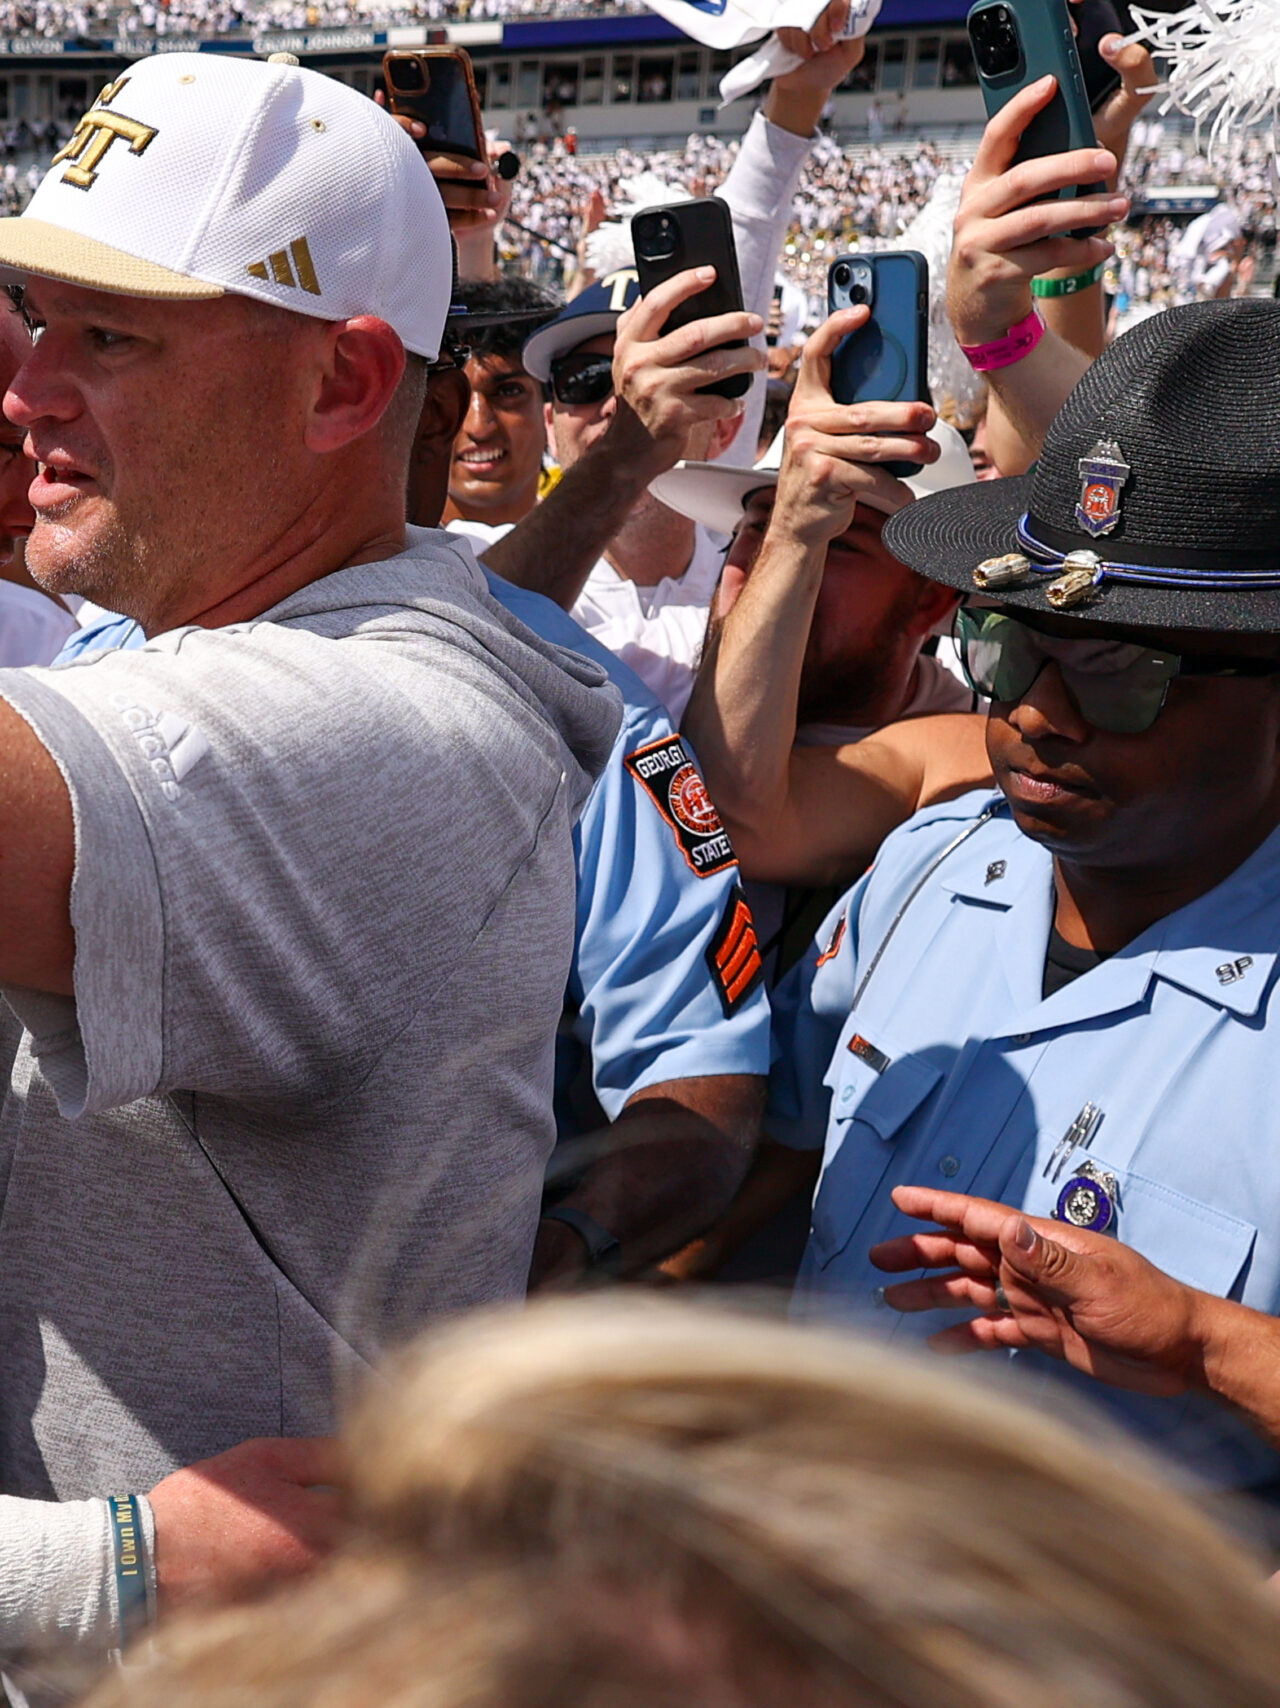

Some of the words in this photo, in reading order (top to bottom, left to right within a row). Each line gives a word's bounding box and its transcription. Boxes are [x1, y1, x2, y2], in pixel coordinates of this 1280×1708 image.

[305, 33, 375, 51] JOHNSON
[635, 745, 687, 779] GEORGI
[691, 836, 730, 866] STATE
[1215, 955, 1253, 986] SP
[116, 1503, 133, 1524] My
[120, 1527, 137, 1565] Own
